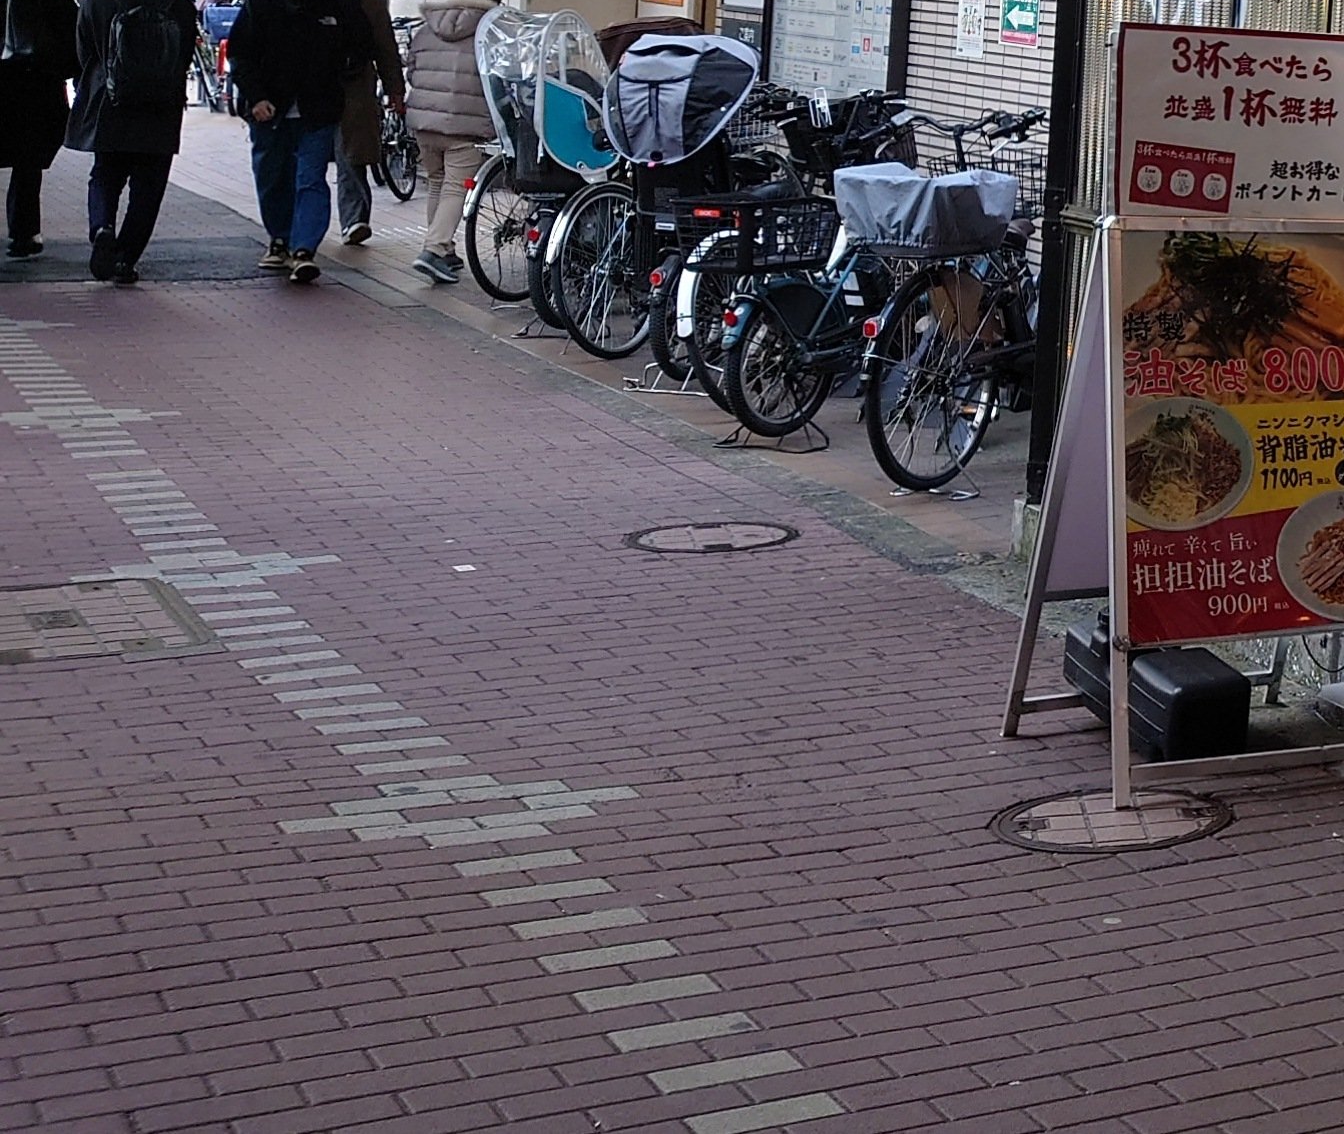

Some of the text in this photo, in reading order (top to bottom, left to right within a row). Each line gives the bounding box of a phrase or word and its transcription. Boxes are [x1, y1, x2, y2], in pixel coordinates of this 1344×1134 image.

[1172, 36, 1333, 82] 3杯食べたら
[1163, 86, 1338, 127] 並盛1杯無料
[1269, 160, 1341, 181] 超お得な
[1123, 312, 1186, 342] 特製
[1123, 347, 1248, 396] 油そば
[1260, 467, 1313, 490] 1100円
[1133, 532, 1257, 558] 痺れて 辛くて 旨い
[1132, 556, 1274, 595] 担担油そば
[1208, 592, 1268, 616] 900円
